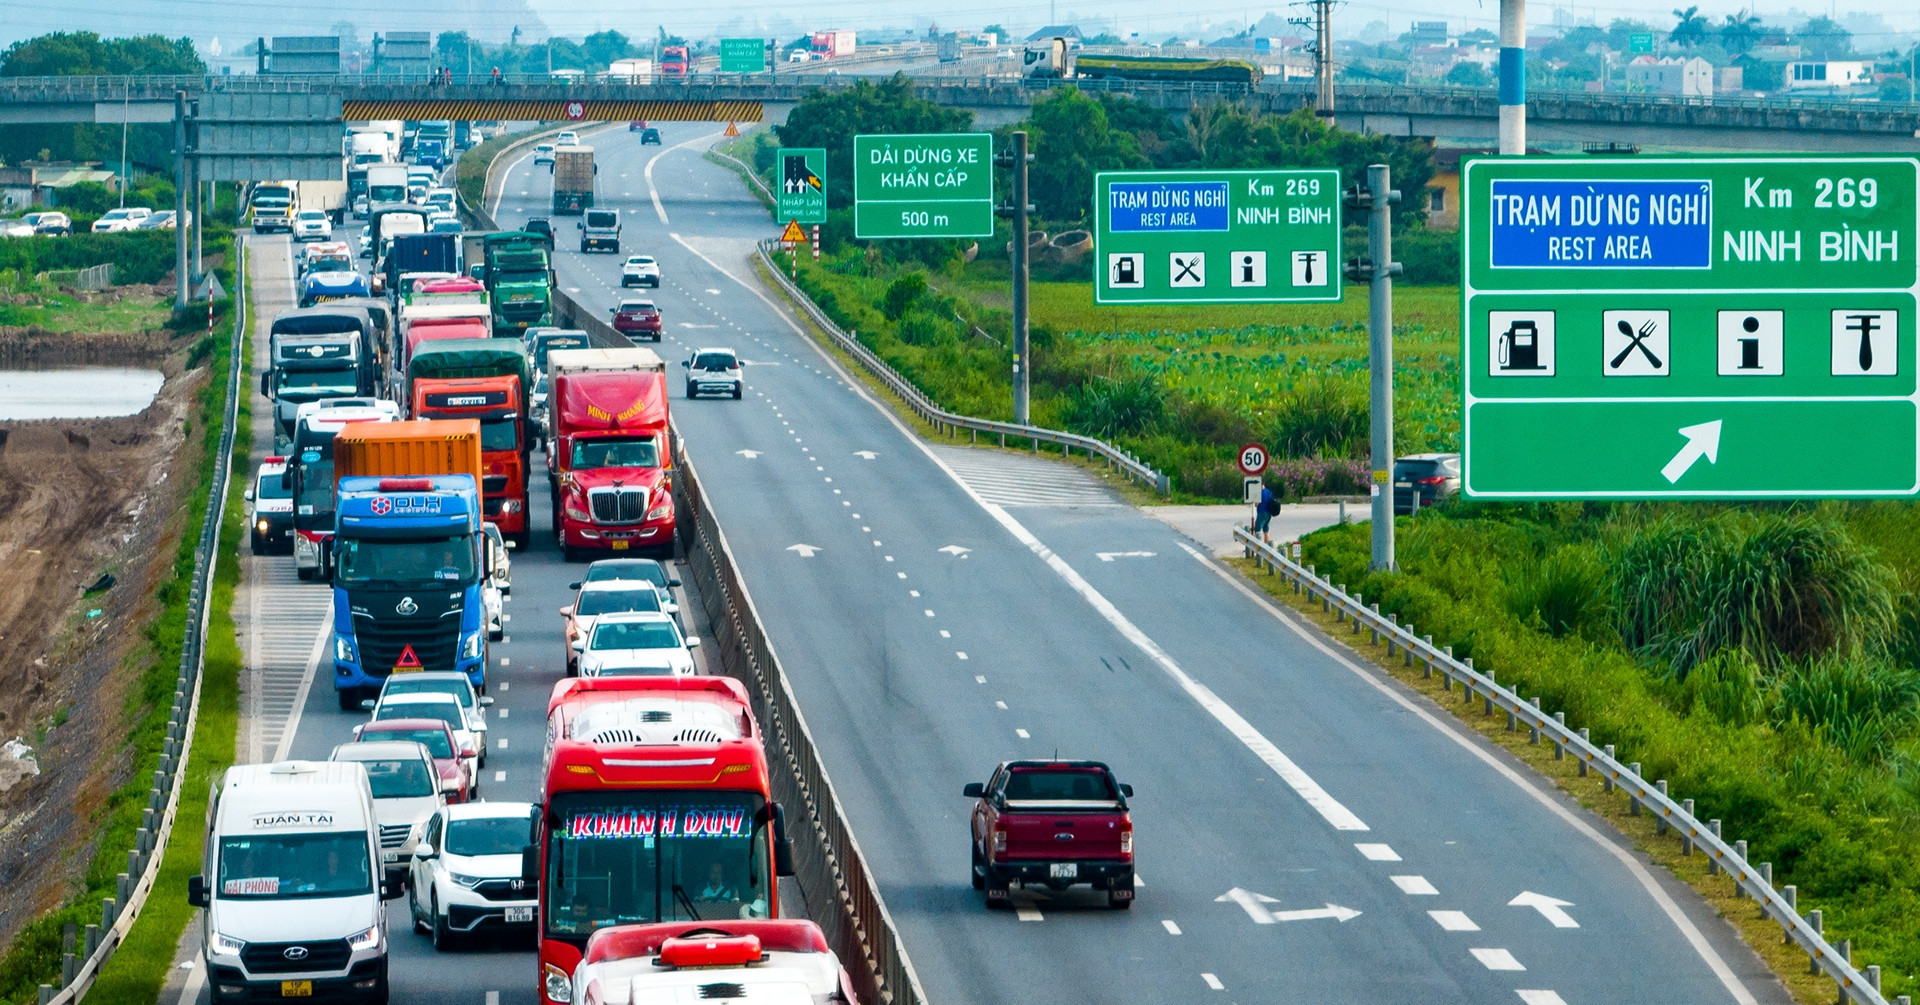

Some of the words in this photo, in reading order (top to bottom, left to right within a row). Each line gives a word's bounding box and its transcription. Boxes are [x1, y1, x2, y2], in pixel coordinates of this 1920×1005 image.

[870, 143, 898, 164] DẢI
[904, 144, 951, 164] DỪNG
[957, 148, 978, 163] XE
[881, 166, 929, 187] KHẨN
[935, 166, 968, 187] CẤP
[1111, 190, 1148, 211] TRẠM
[1152, 186, 1190, 208] DỪNG
[1194, 184, 1226, 207] NGHỈ
[1248, 179, 1274, 196] Km
[1286, 179, 1320, 196] 269
[1744, 177, 1792, 208] Km
[1814, 177, 1878, 208] 269
[902, 212, 929, 226] 500
[934, 215, 948, 226] m
[1140, 212, 1166, 226] REST
[1170, 212, 1196, 226] AREA
[1237, 207, 1279, 225] NINH
[1288, 204, 1331, 224] BÌNH
[1493, 193, 1561, 233] TRẠM
[1570, 186, 1640, 227] DỪNG
[1649, 184, 1709, 226] NGHỈ
[1548, 236, 1597, 261] REST
[1603, 235, 1653, 260] AREA
[1724, 230, 1801, 262] NINH
[1819, 223, 1898, 262] BÌNH
[588, 404, 611, 422] MINH
[617, 399, 645, 421] KHANG
[1244, 452, 1262, 466] 50
[394, 496, 441, 508] DLH
[244, 878, 278, 894] PHÒNG
